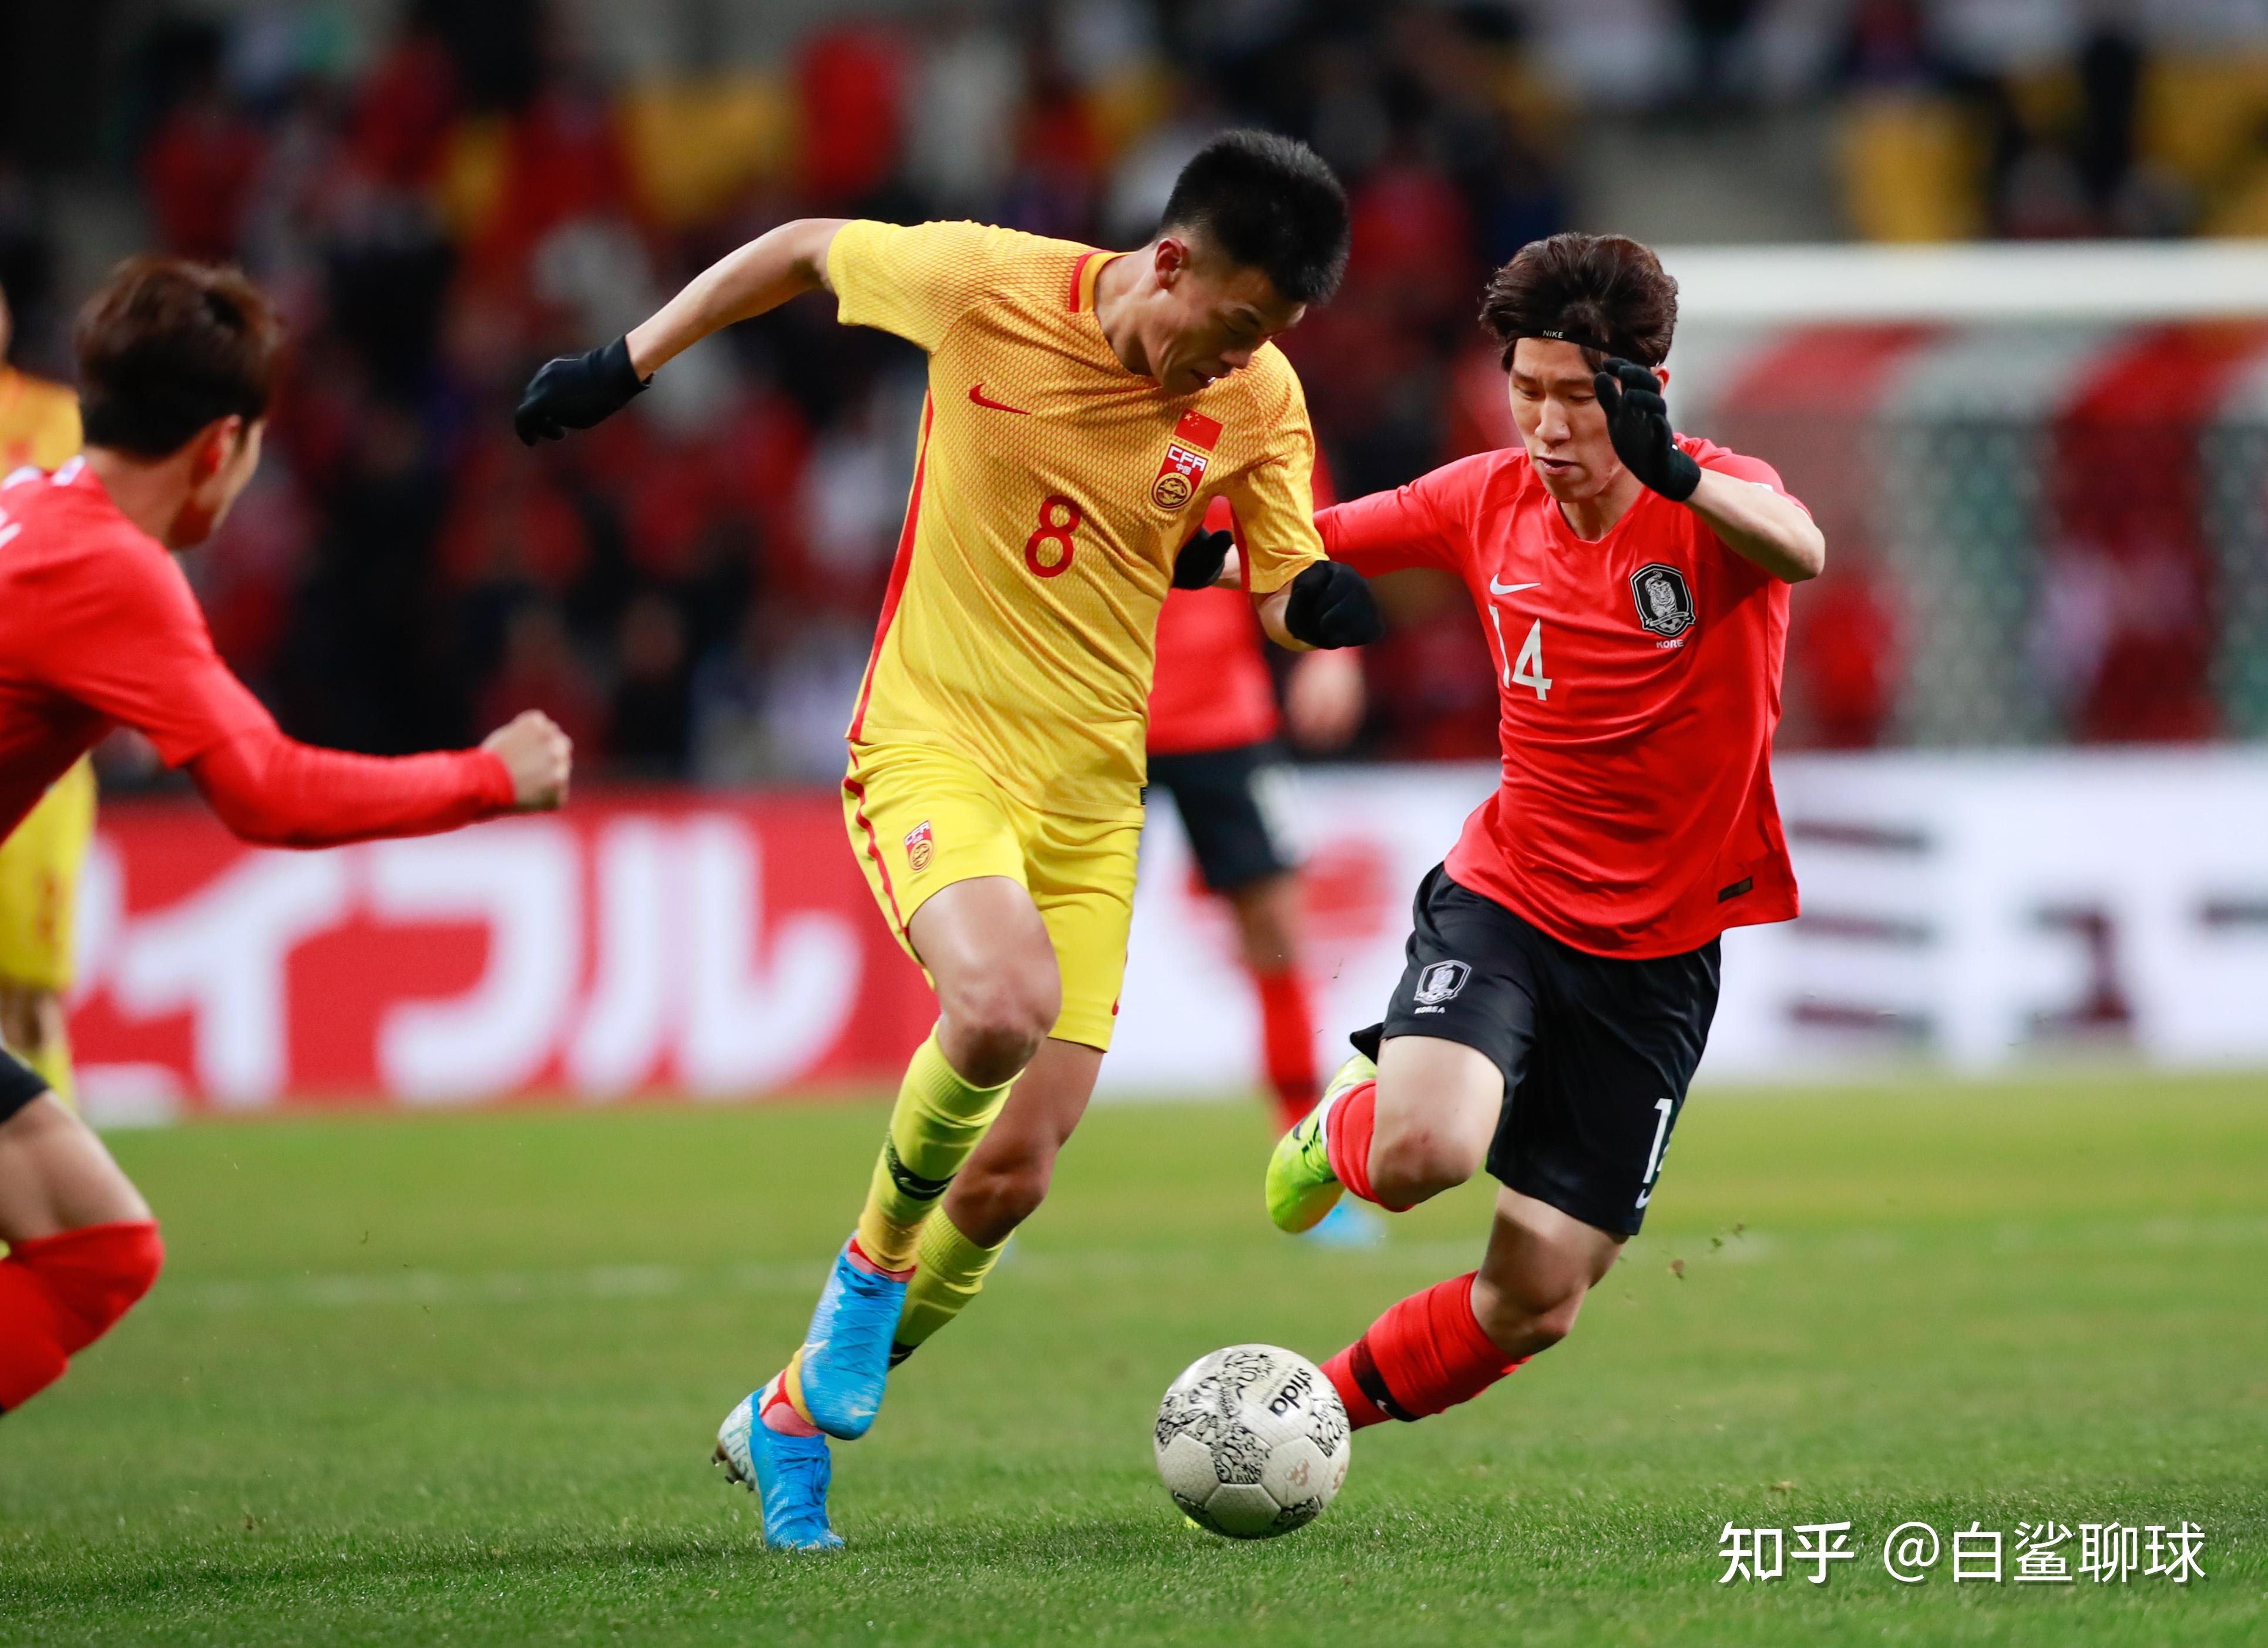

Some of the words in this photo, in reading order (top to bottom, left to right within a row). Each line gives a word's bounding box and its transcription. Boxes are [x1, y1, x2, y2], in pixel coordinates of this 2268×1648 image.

[1543, 329, 1564, 339] NIKE
[1168, 446, 1207, 472] CFA
[1025, 495, 1081, 578] 8
[1488, 604, 1552, 701] 14
[1657, 639, 1684, 648] KORE
[1642, 1098, 1673, 1183] 1
[1269, 1367, 1312, 1417] sfida
